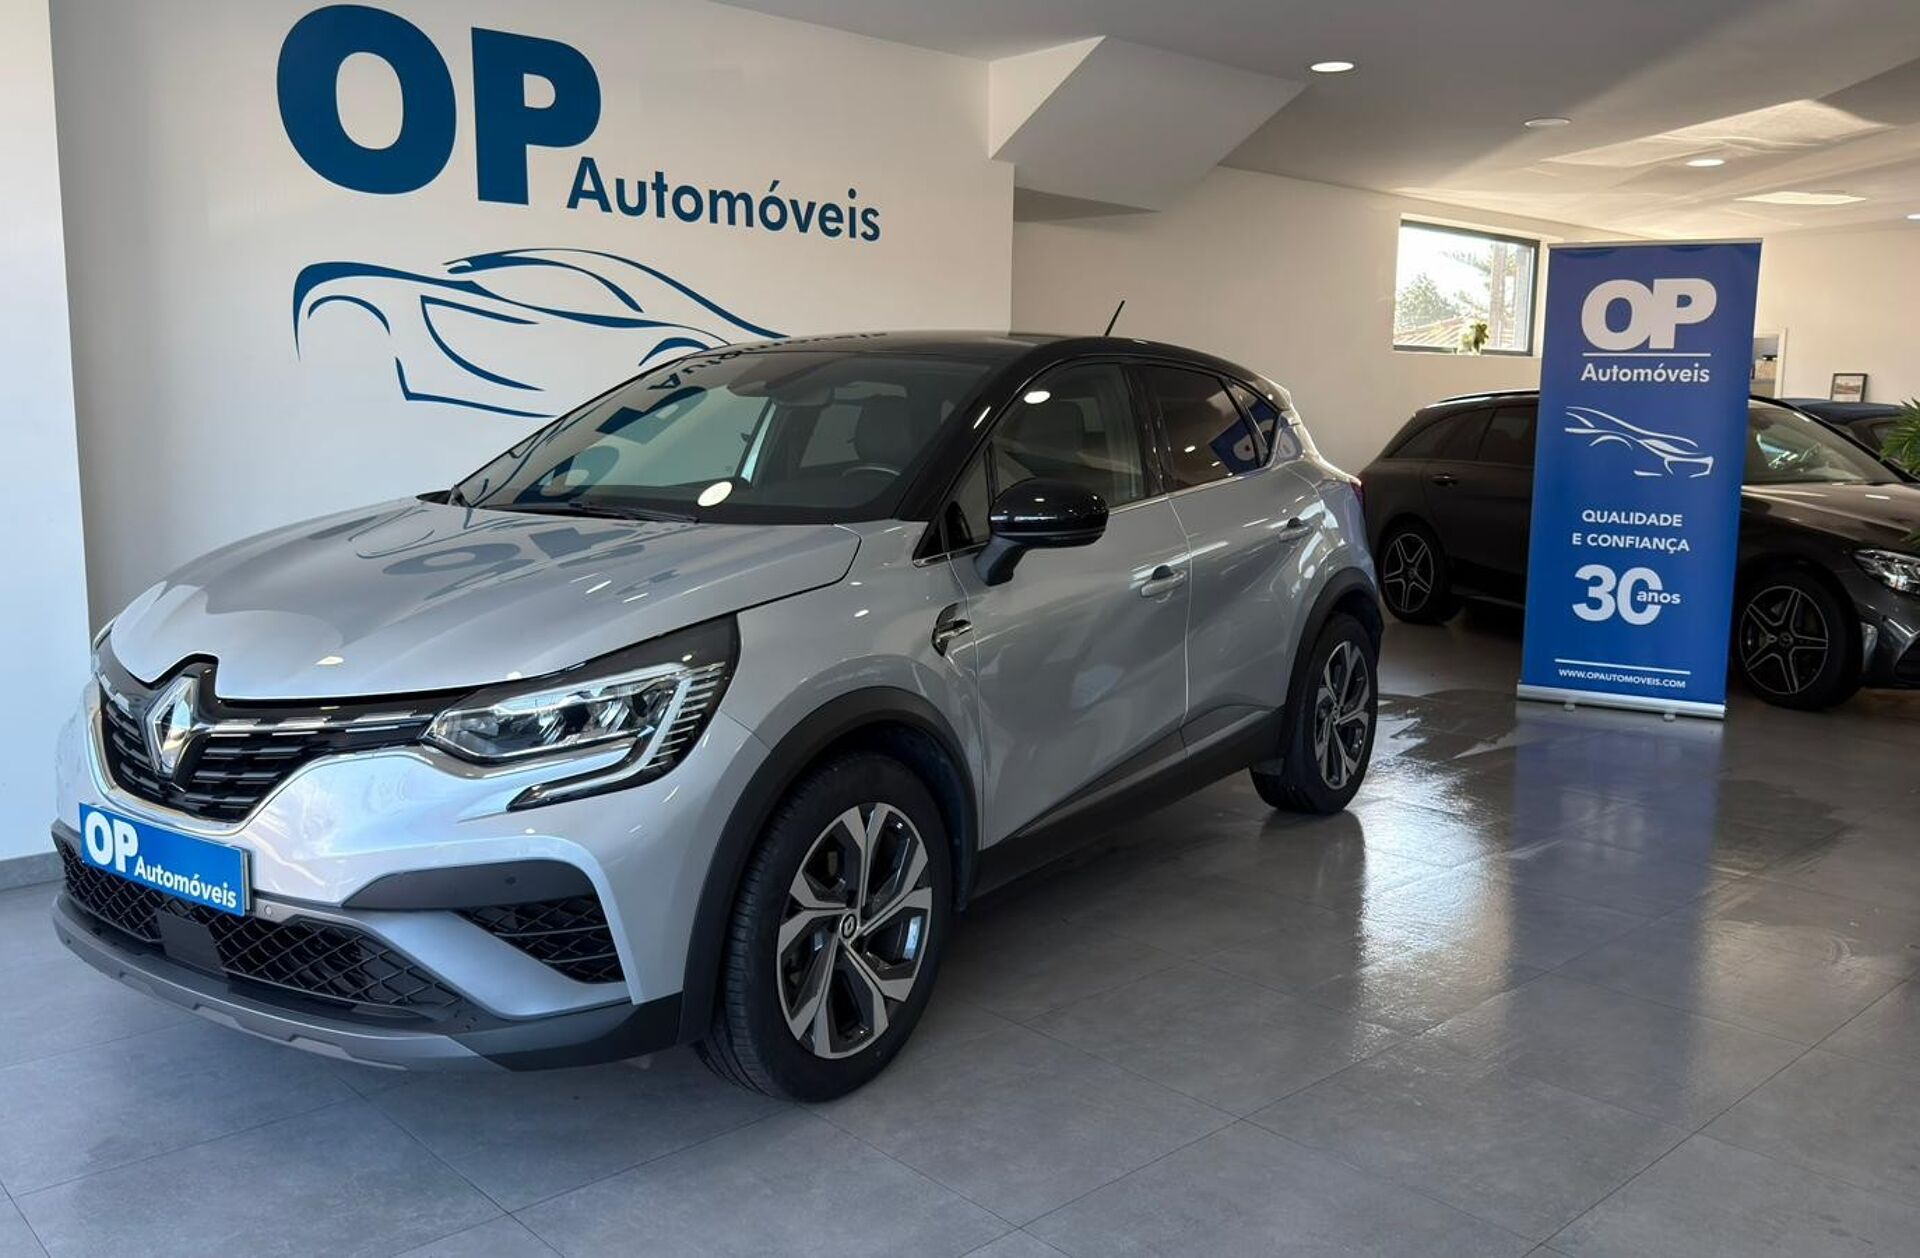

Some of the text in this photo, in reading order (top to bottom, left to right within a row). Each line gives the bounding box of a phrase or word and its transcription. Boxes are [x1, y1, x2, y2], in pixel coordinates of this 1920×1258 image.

[276, 3, 881, 242] OP Automóveis
[1581, 277, 1717, 351] OP
[1580, 361, 1710, 383] Automóveis
[1582, 509, 1683, 527] QUALIDADE
[1572, 532, 1690, 554] E CONFIANÇA
[1572, 564, 1681, 625] 30 anos
[1558, 669, 1686, 688] WWW.OPAUTOMOVEIS.COM
[85, 811, 237, 908] OP Automóveis
